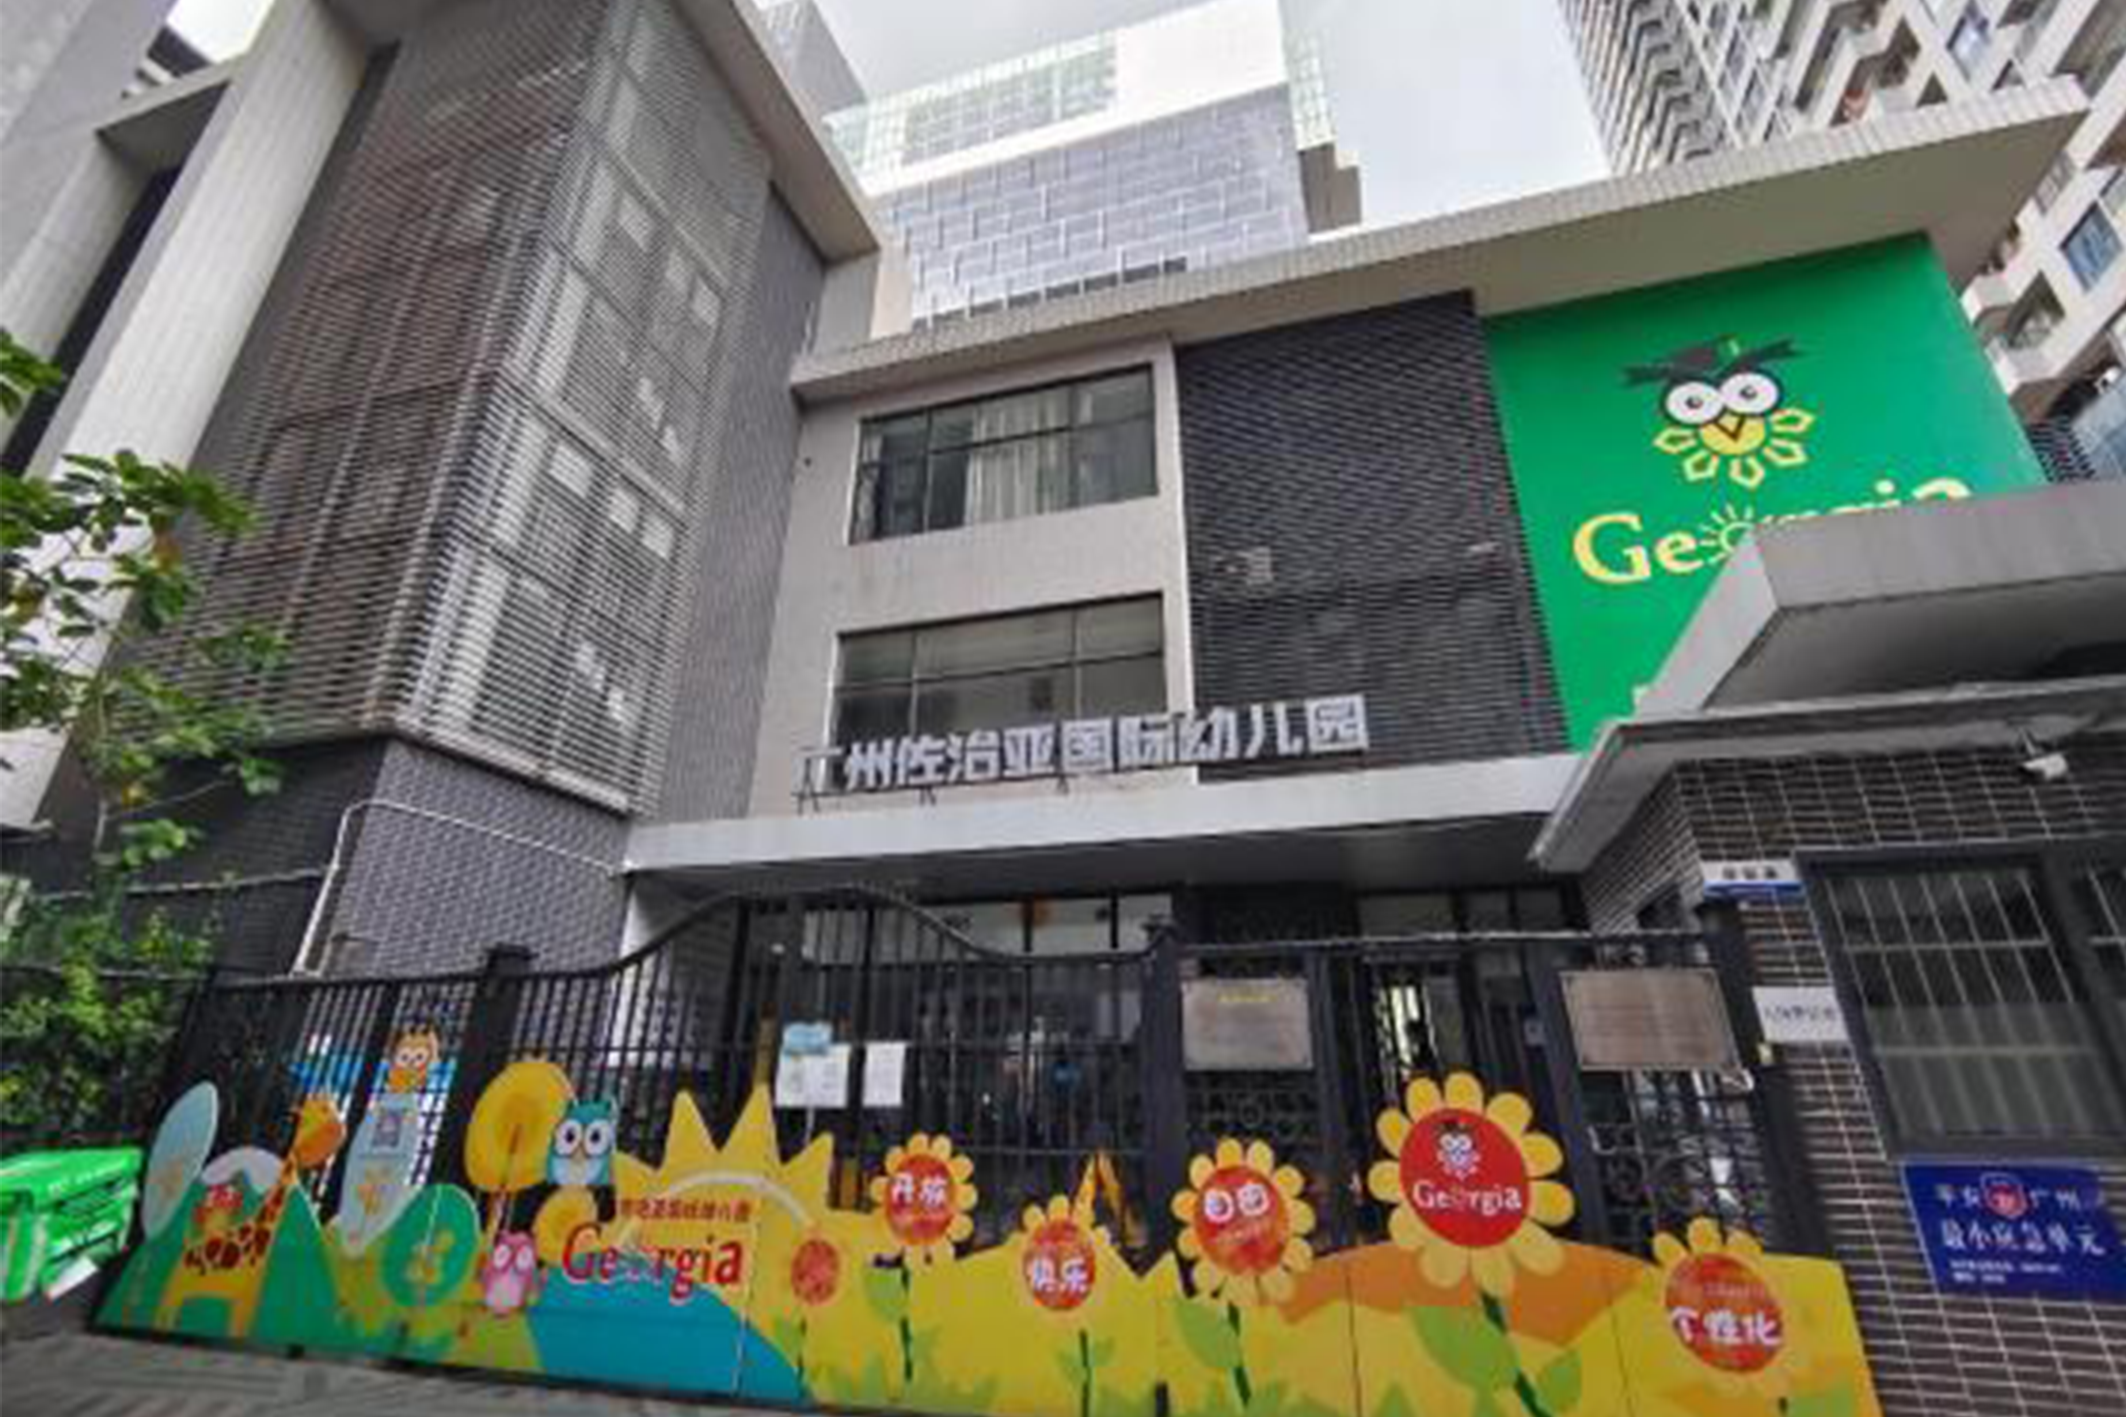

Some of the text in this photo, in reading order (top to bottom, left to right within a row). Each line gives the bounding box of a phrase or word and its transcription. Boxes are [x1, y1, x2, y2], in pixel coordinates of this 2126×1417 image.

[800, 694, 1369, 794] 广州佐治亚国际幼儿园
[1413, 1179, 1521, 1216] Georgia
[561, 1221, 744, 1305] Georgia
[1670, 1306, 1782, 1346] 个性化
